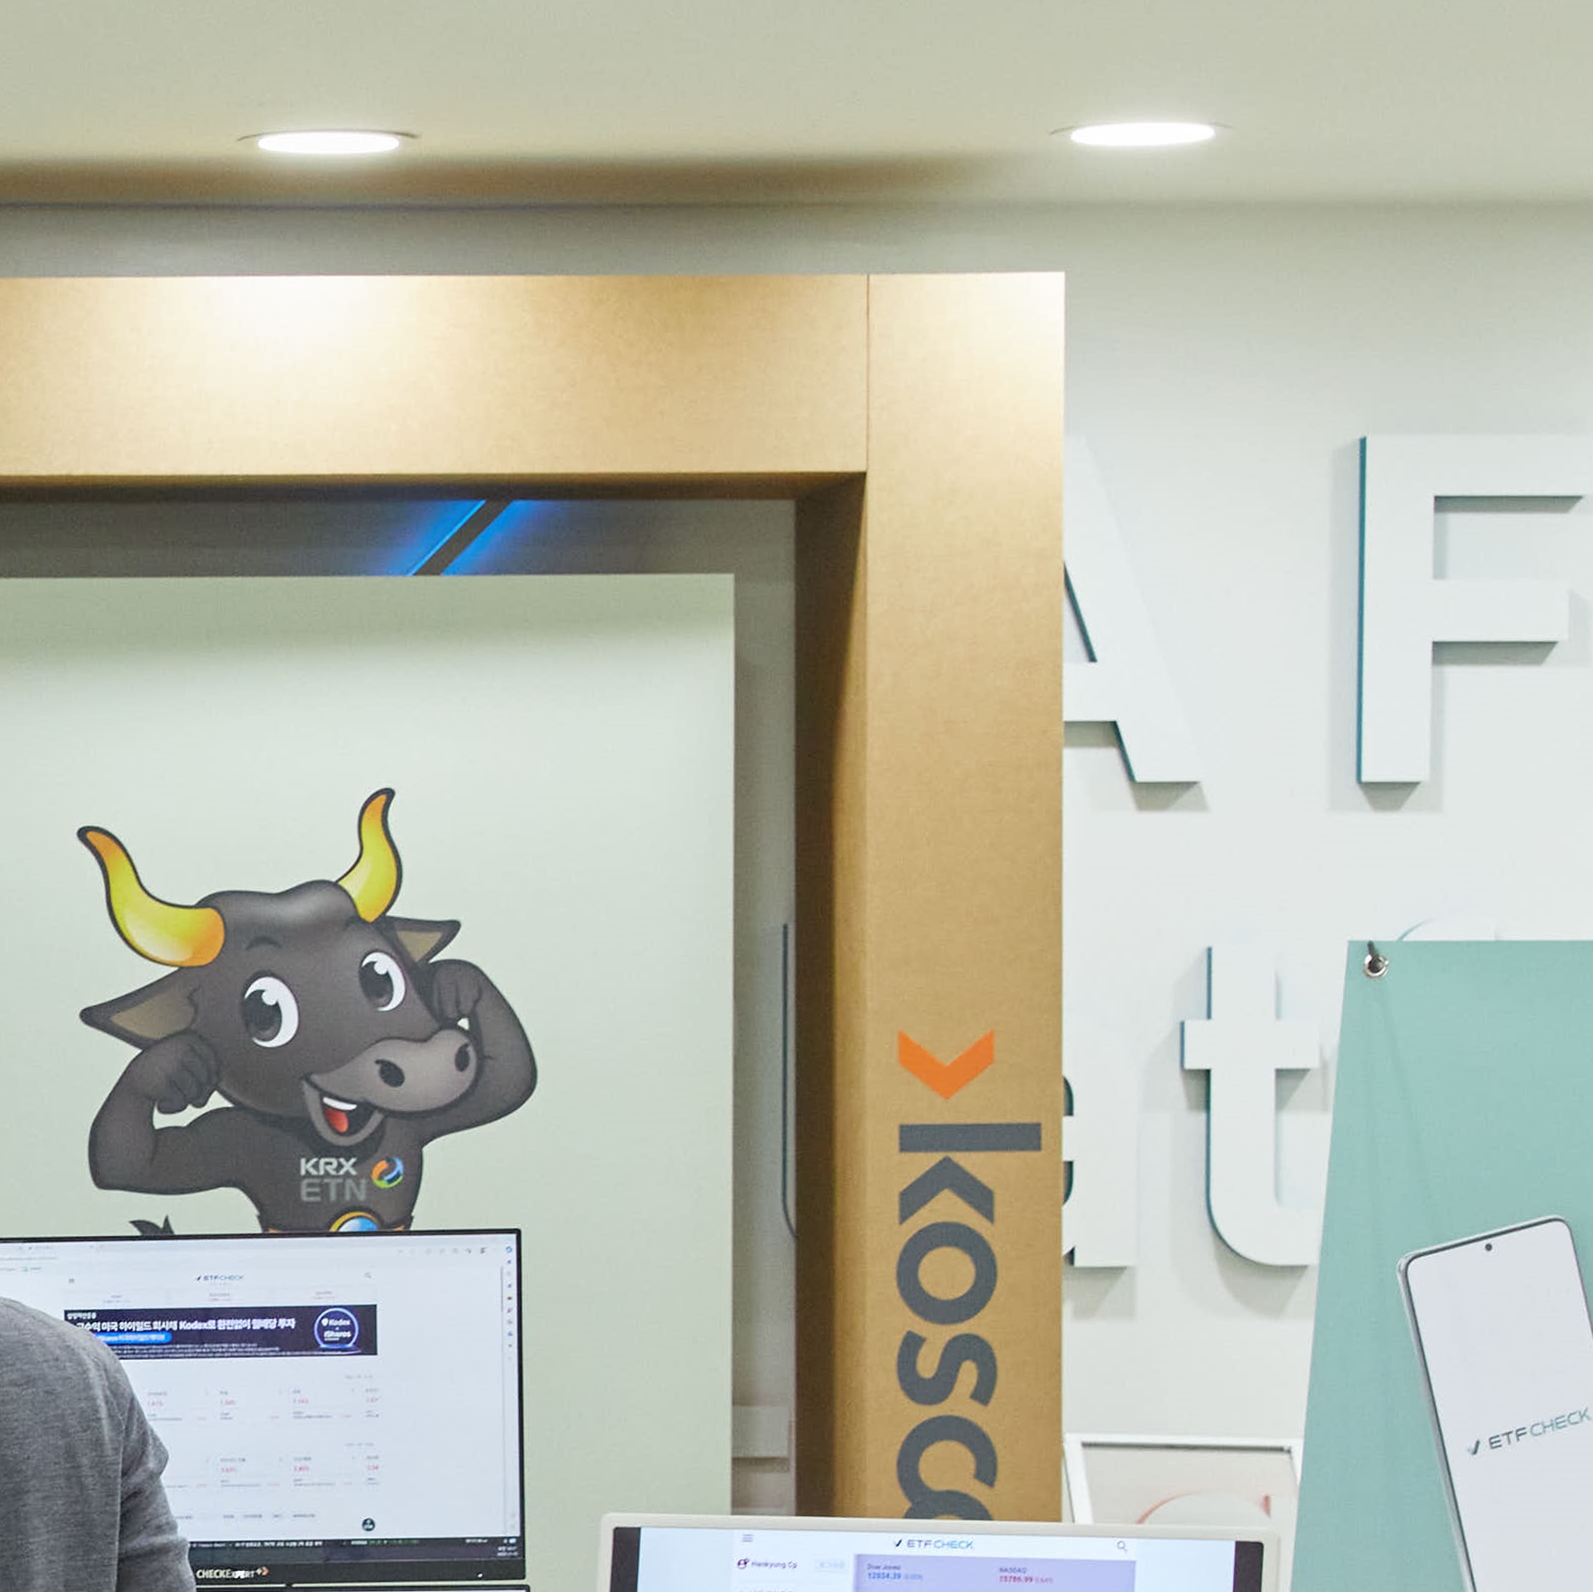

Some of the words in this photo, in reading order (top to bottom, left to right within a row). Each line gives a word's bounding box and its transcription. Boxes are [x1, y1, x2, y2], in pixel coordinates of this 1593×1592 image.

[300, 1157, 358, 1176] KRX
[300, 1178, 366, 1203] ETN
[896, 1121, 1043, 1520] kosc
